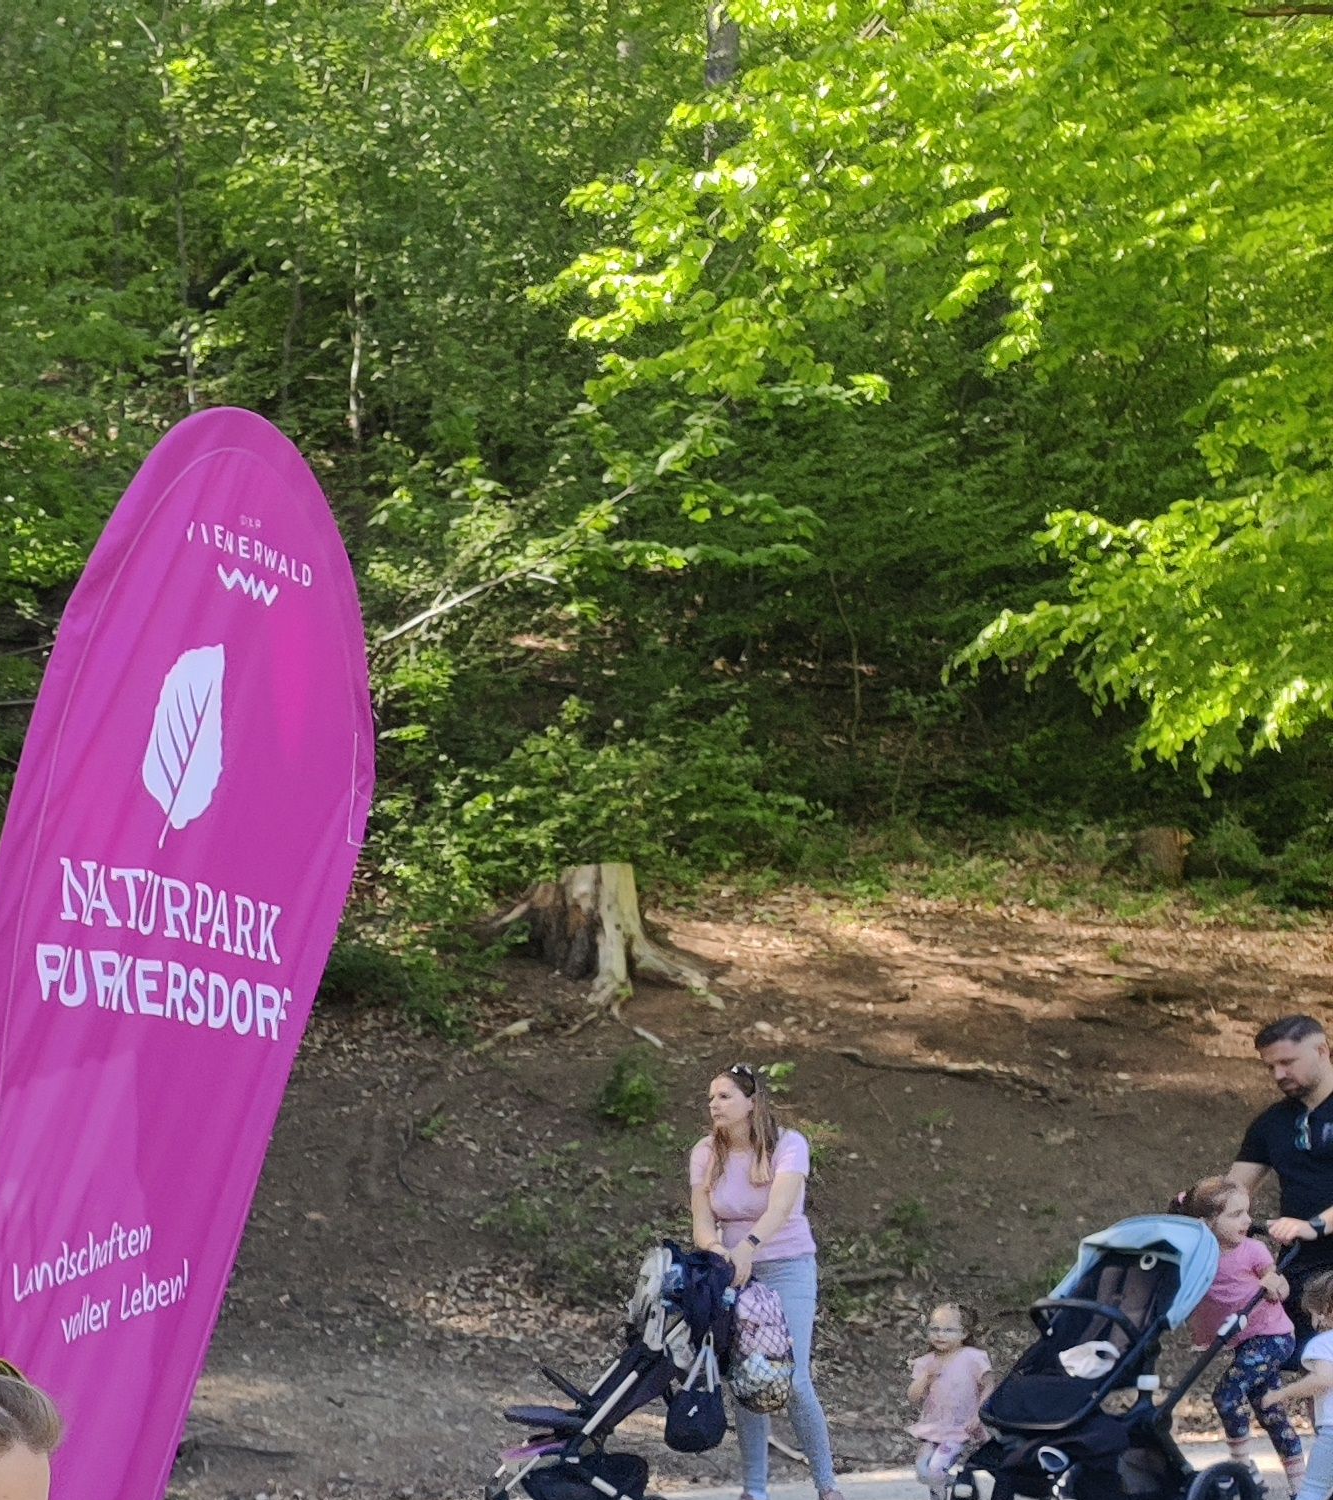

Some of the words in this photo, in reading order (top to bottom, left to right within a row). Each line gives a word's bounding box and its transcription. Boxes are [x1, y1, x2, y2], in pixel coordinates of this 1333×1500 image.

[59, 856, 282, 966] NATURPARK
[35, 942, 293, 1042] PURKERSDORF
[12, 1220, 153, 1303] Landschaften
[60, 1293, 112, 1345] voller
[119, 1257, 190, 1322] Leben!
